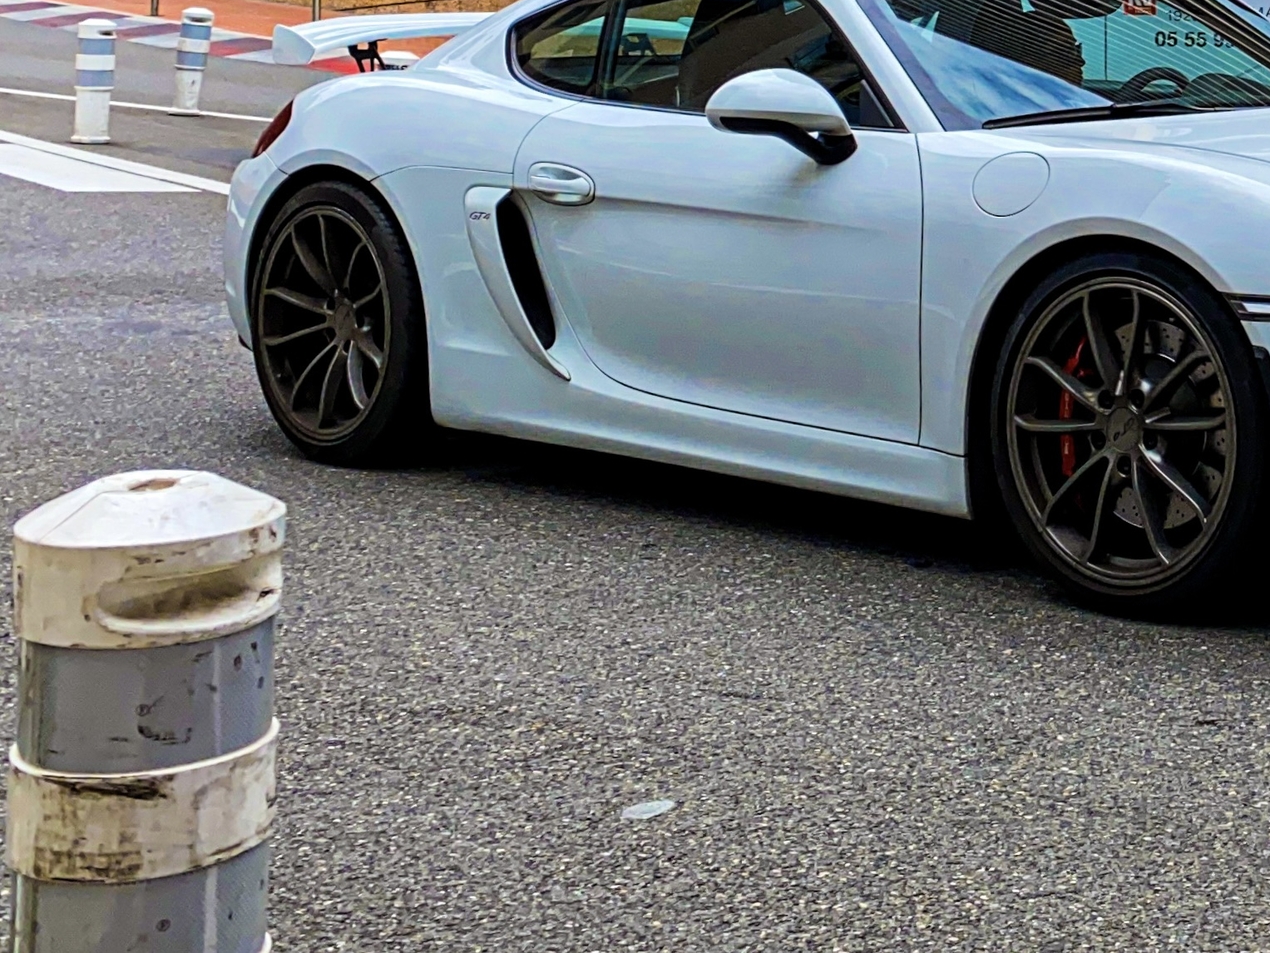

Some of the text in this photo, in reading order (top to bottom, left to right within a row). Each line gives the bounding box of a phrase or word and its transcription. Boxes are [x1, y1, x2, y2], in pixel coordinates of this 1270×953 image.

[1154, 31, 1178, 47] 05
[1184, 31, 1207, 47] 55
[469, 211, 491, 220] GT4
